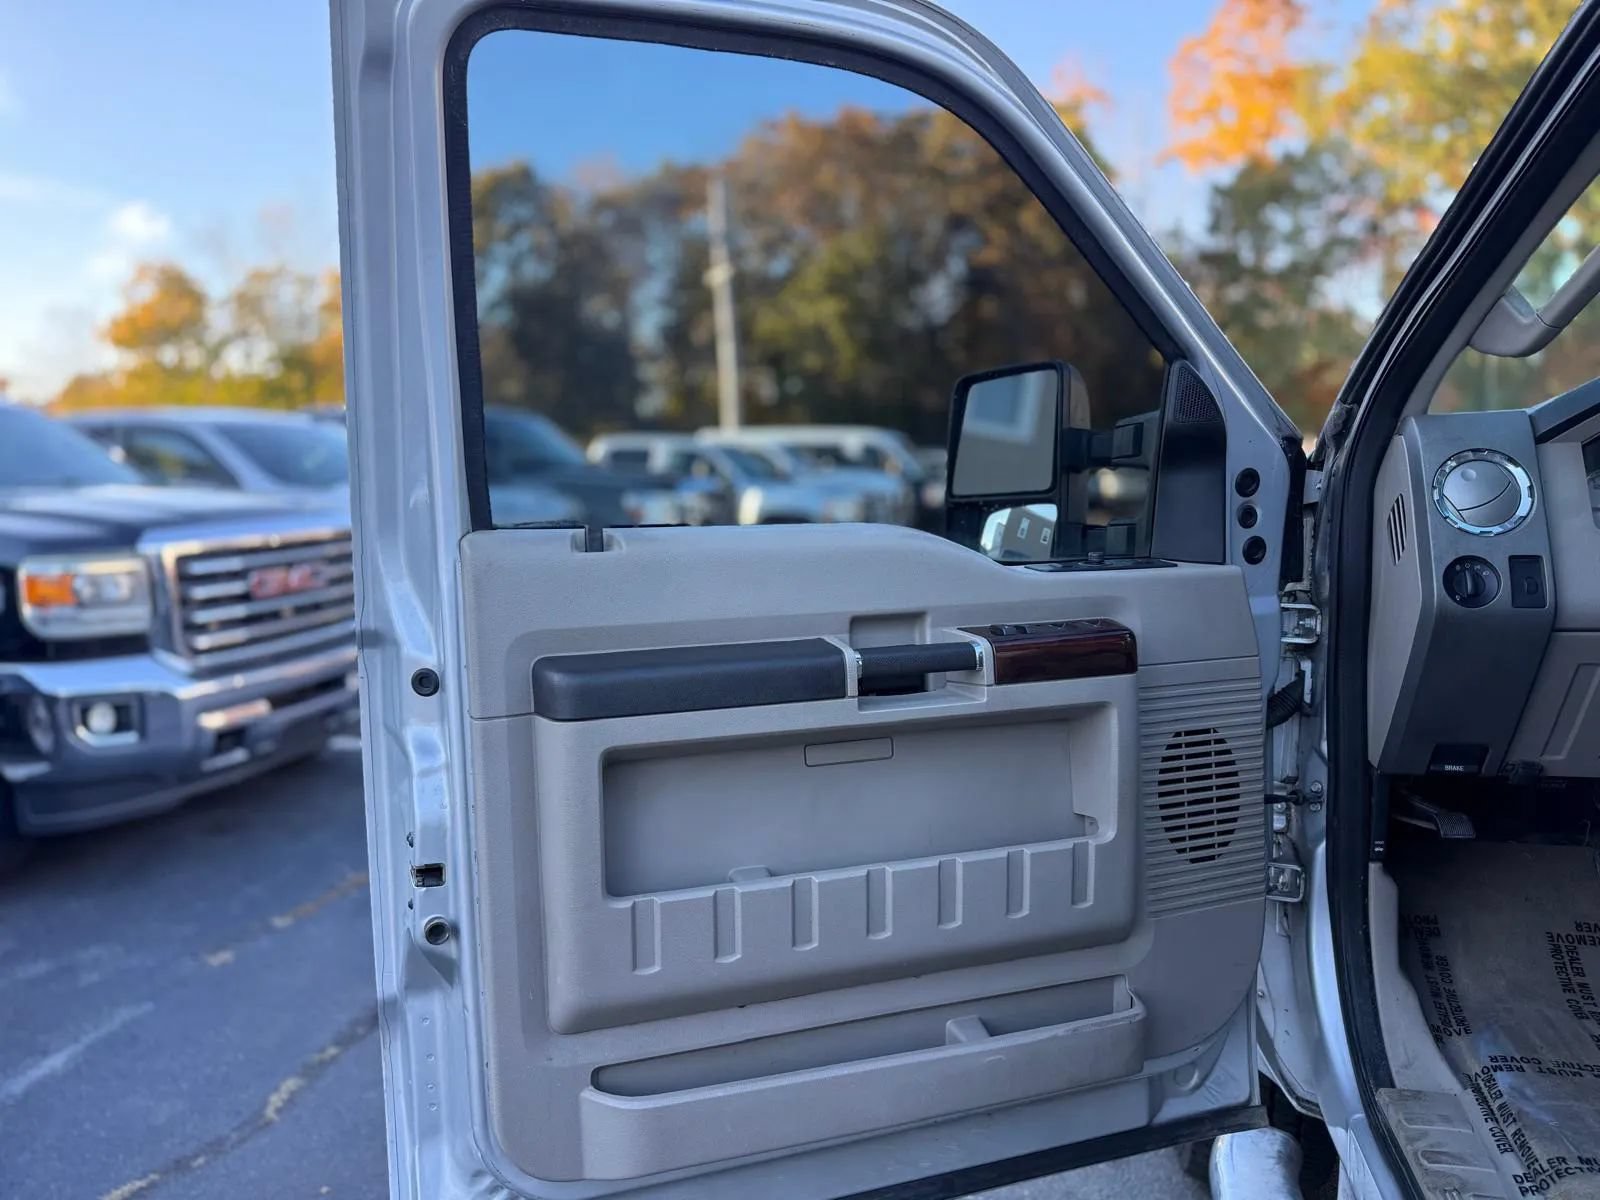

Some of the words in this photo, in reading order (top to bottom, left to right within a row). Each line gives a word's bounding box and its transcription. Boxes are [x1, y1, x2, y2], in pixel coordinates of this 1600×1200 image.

[1548, 943, 1577, 994] PROTECTIVE
[1564, 944, 1586, 978] DEALER
[1576, 982, 1598, 1008] MUST
[1488, 1055, 1542, 1065] COVER
[1481, 1074, 1504, 1103] DEALER
[1496, 1101, 1517, 1128] MUST
[1510, 1127, 1540, 1170] REMOVE
[1489, 1126, 1514, 1155] COVER
[1512, 1156, 1570, 1185] DEALER
